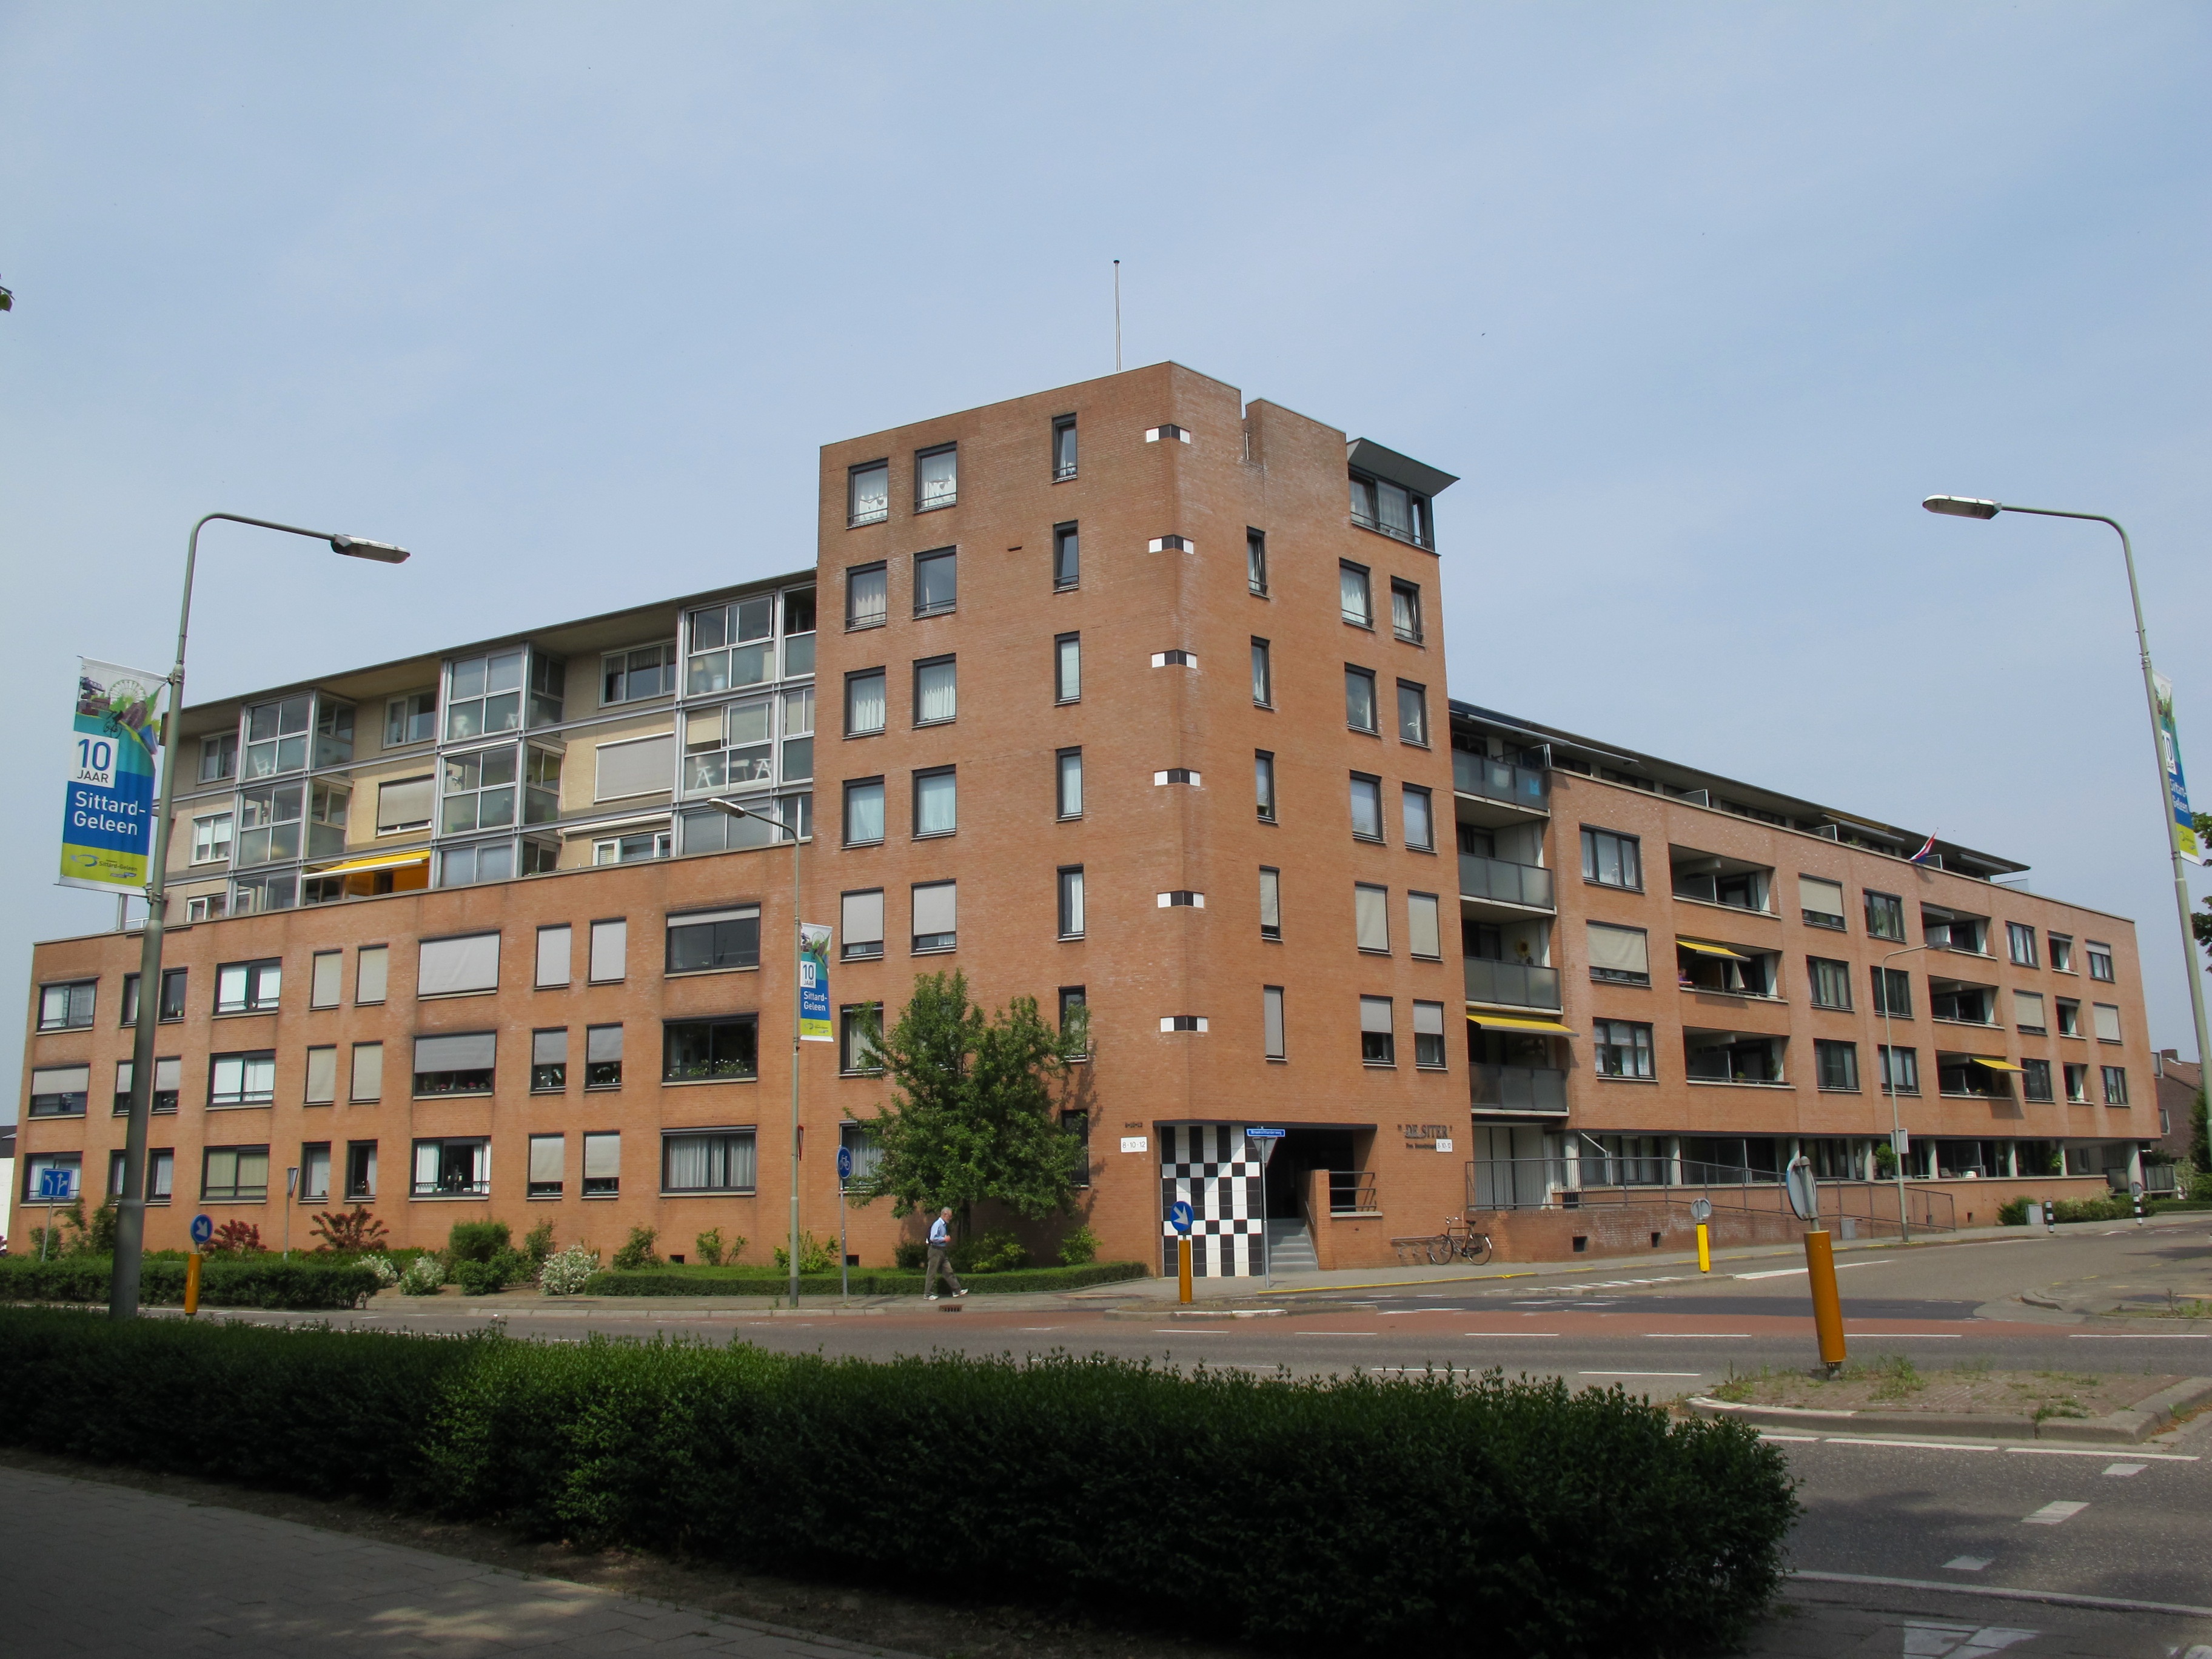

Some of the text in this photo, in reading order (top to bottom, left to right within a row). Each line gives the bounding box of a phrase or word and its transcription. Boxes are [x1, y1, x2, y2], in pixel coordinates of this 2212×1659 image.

[78, 738, 112, 772] 10
[76, 769, 109, 784] JAAR
[75, 791, 147, 817] Sittard-
[73, 810, 138, 836] Geleen
[802, 964, 814, 980] 10
[803, 990, 828, 1001] Sittard-
[803, 1000, 826, 1011] Geleen
